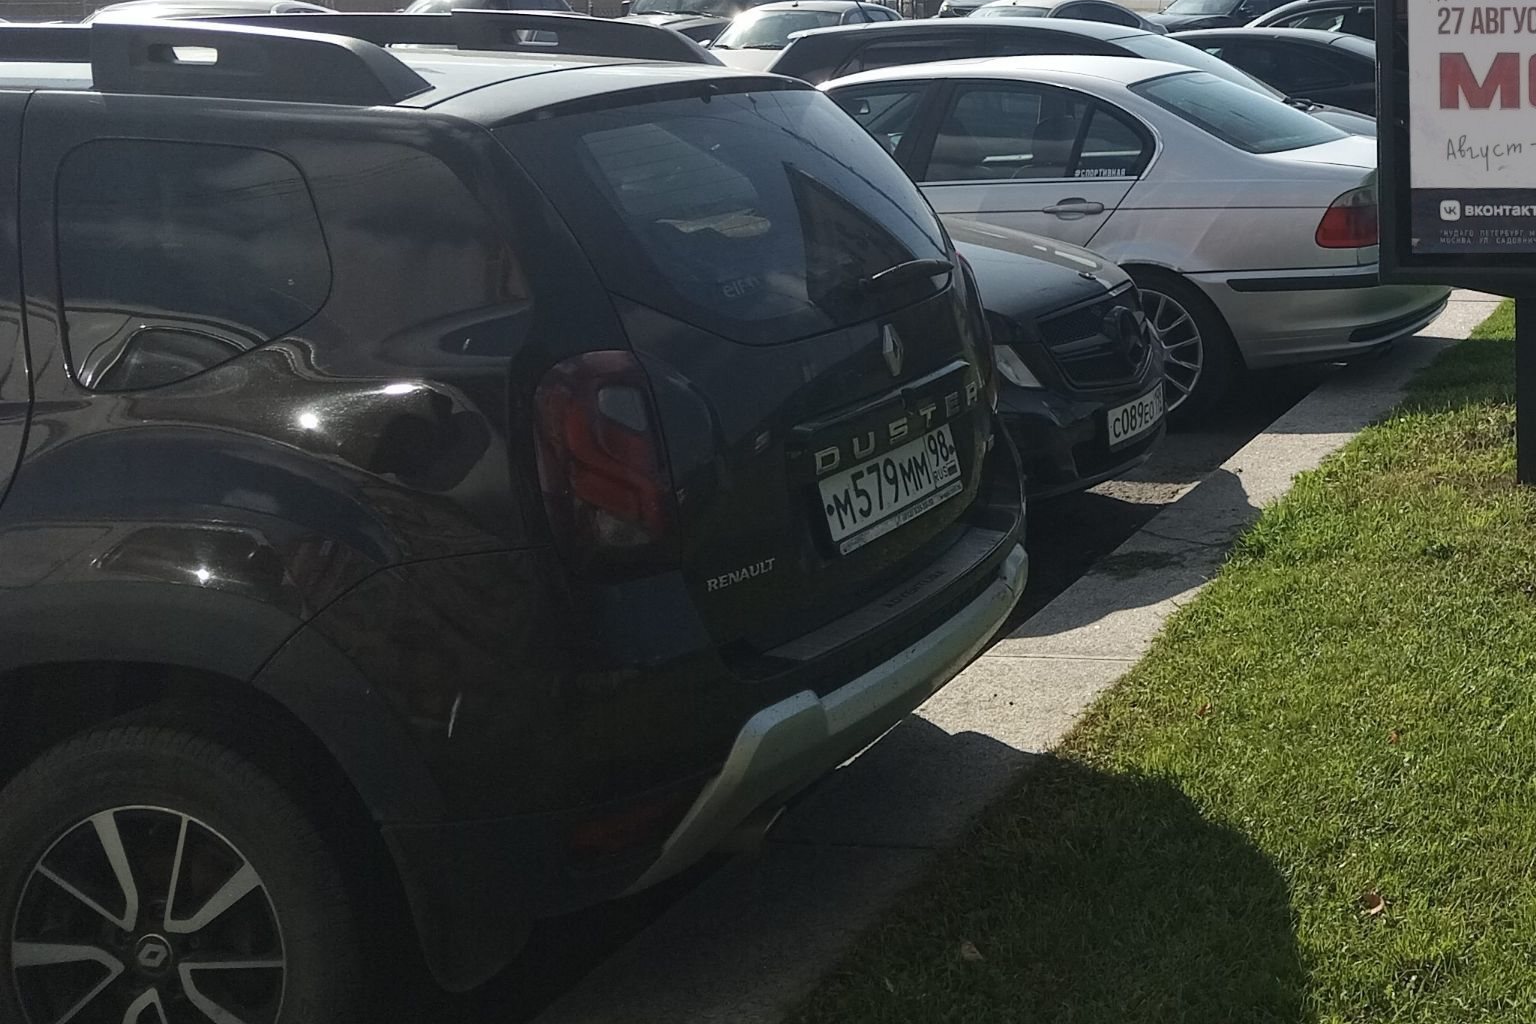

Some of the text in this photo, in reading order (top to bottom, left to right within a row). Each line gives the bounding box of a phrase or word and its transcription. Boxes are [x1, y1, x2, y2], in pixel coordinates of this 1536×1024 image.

[1437, 6, 1465, 35] 27
[1446, 134, 1523, 171] Август
[814, 381, 979, 475] DUSTER
[706, 557, 776, 592] RENAULT
